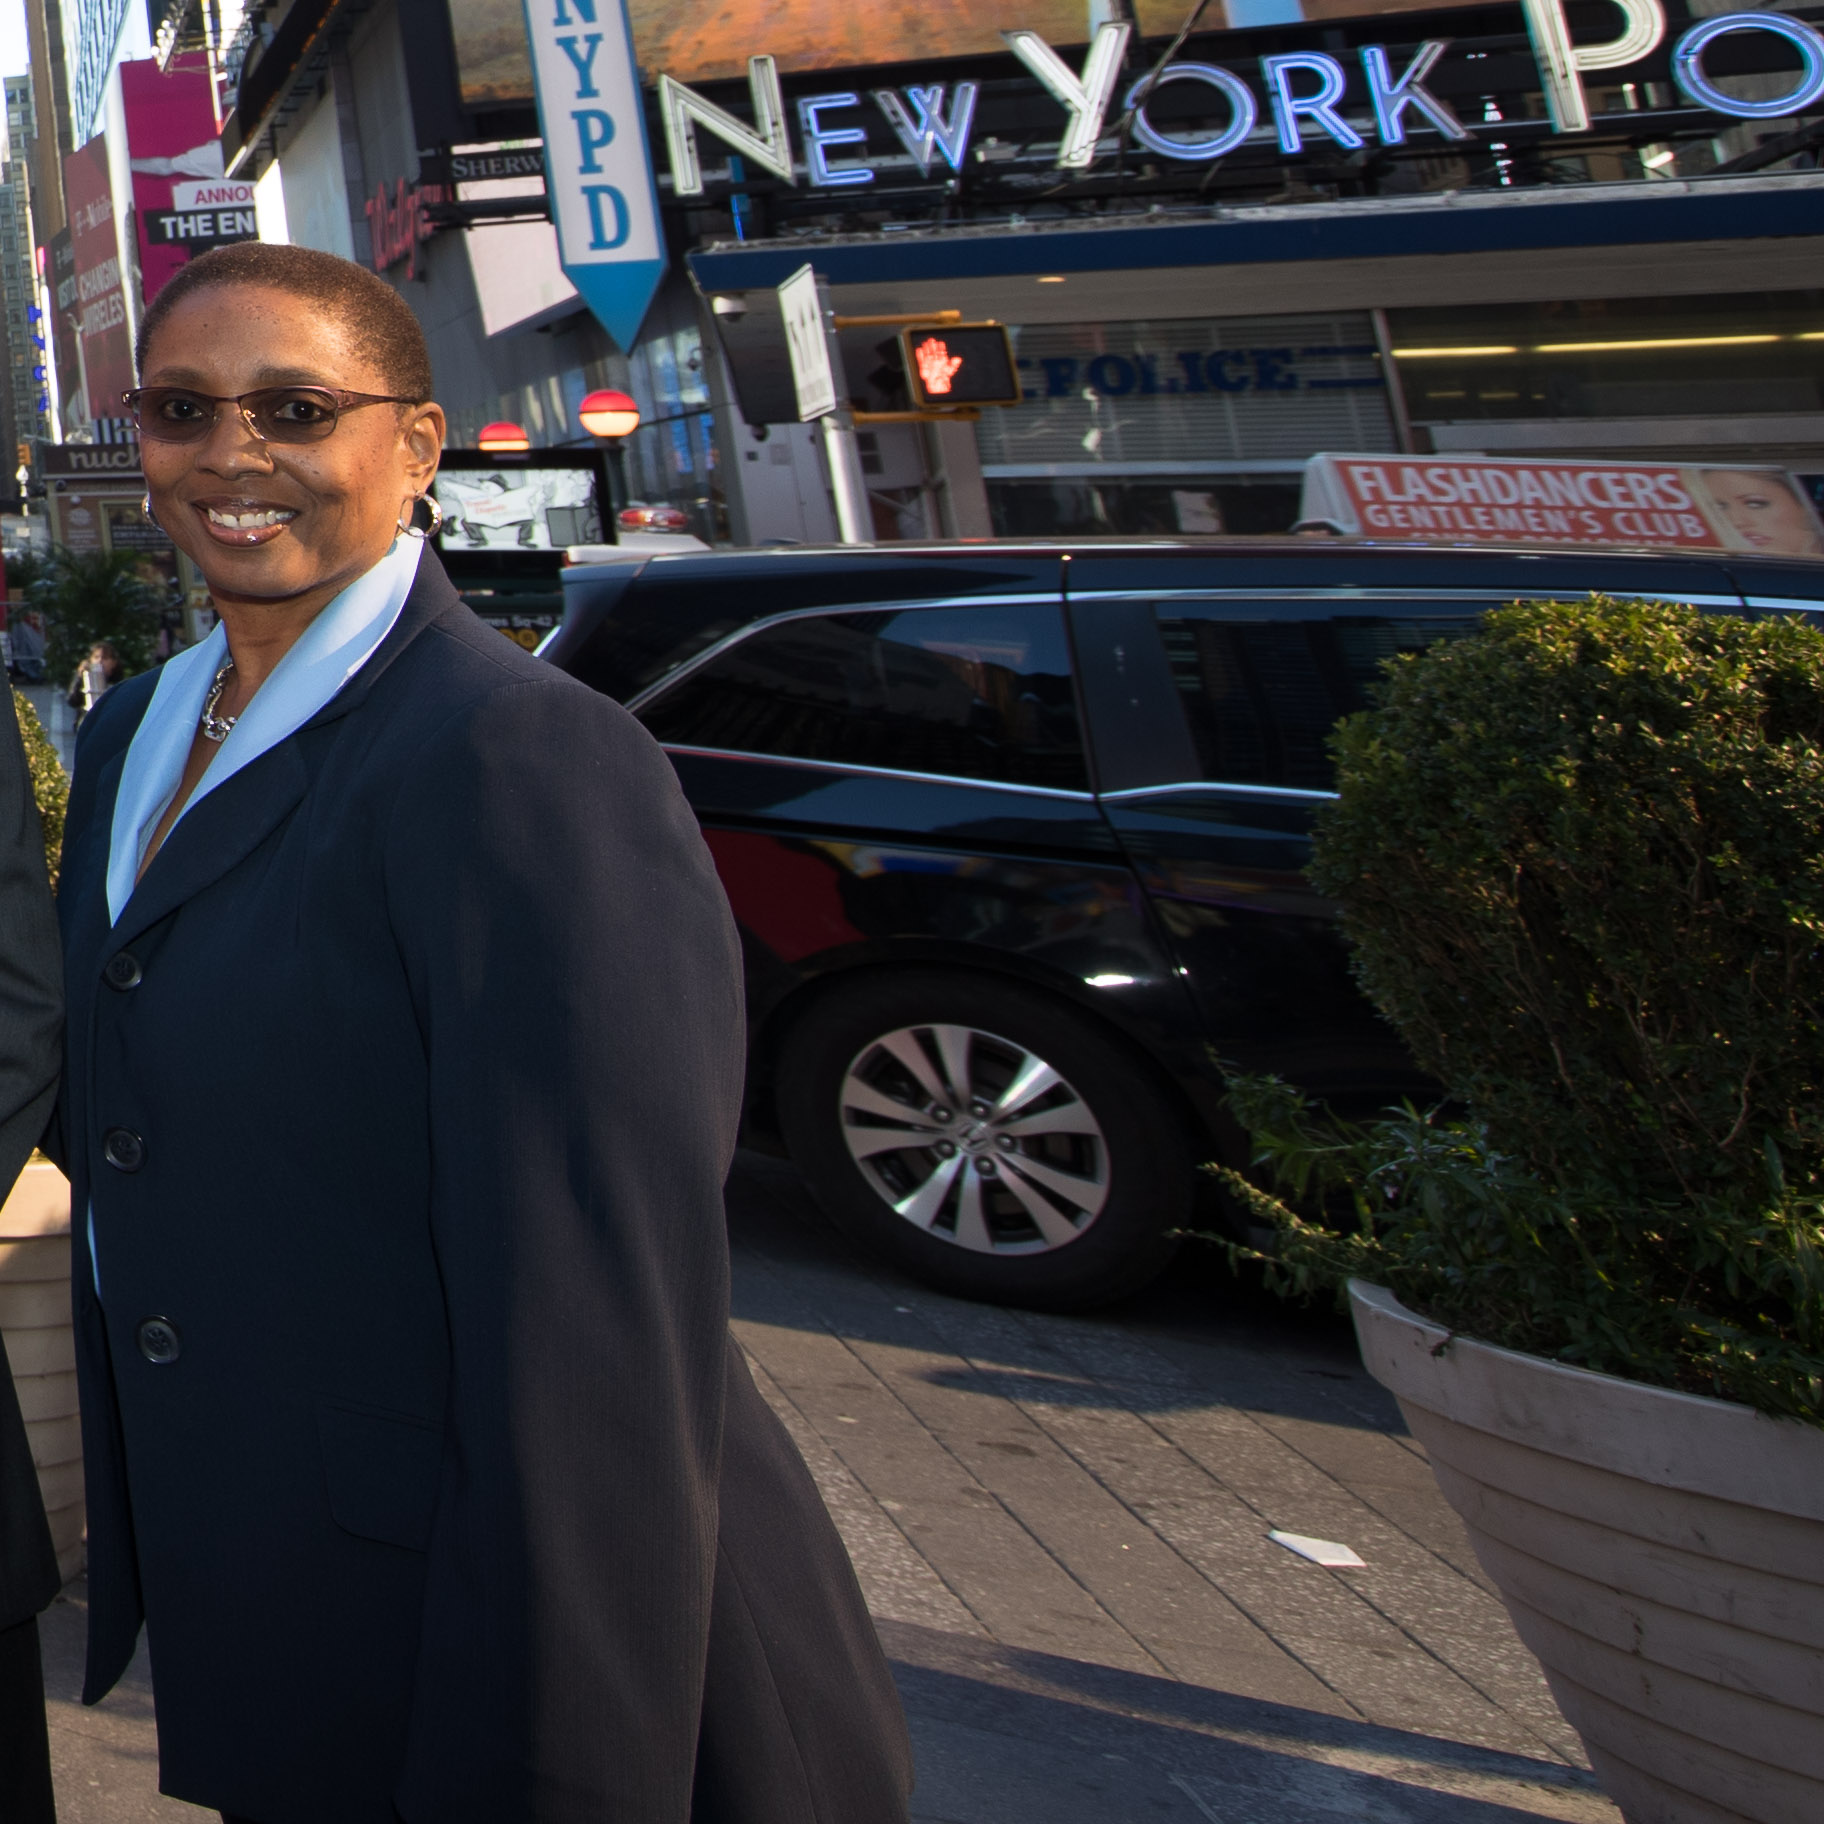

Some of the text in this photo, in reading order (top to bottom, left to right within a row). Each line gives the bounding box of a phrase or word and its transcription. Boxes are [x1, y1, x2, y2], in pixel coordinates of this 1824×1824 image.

[656, 54, 981, 198] NEW
[1002, 21, 1474, 170] YORK
[159, 213, 214, 239] THE
[1039, 347, 1300, 398] POLICE
[1348, 465, 1693, 511] FLASHDANCERS
[1364, 503, 1707, 539] GENTLEMEN'S CLUB
